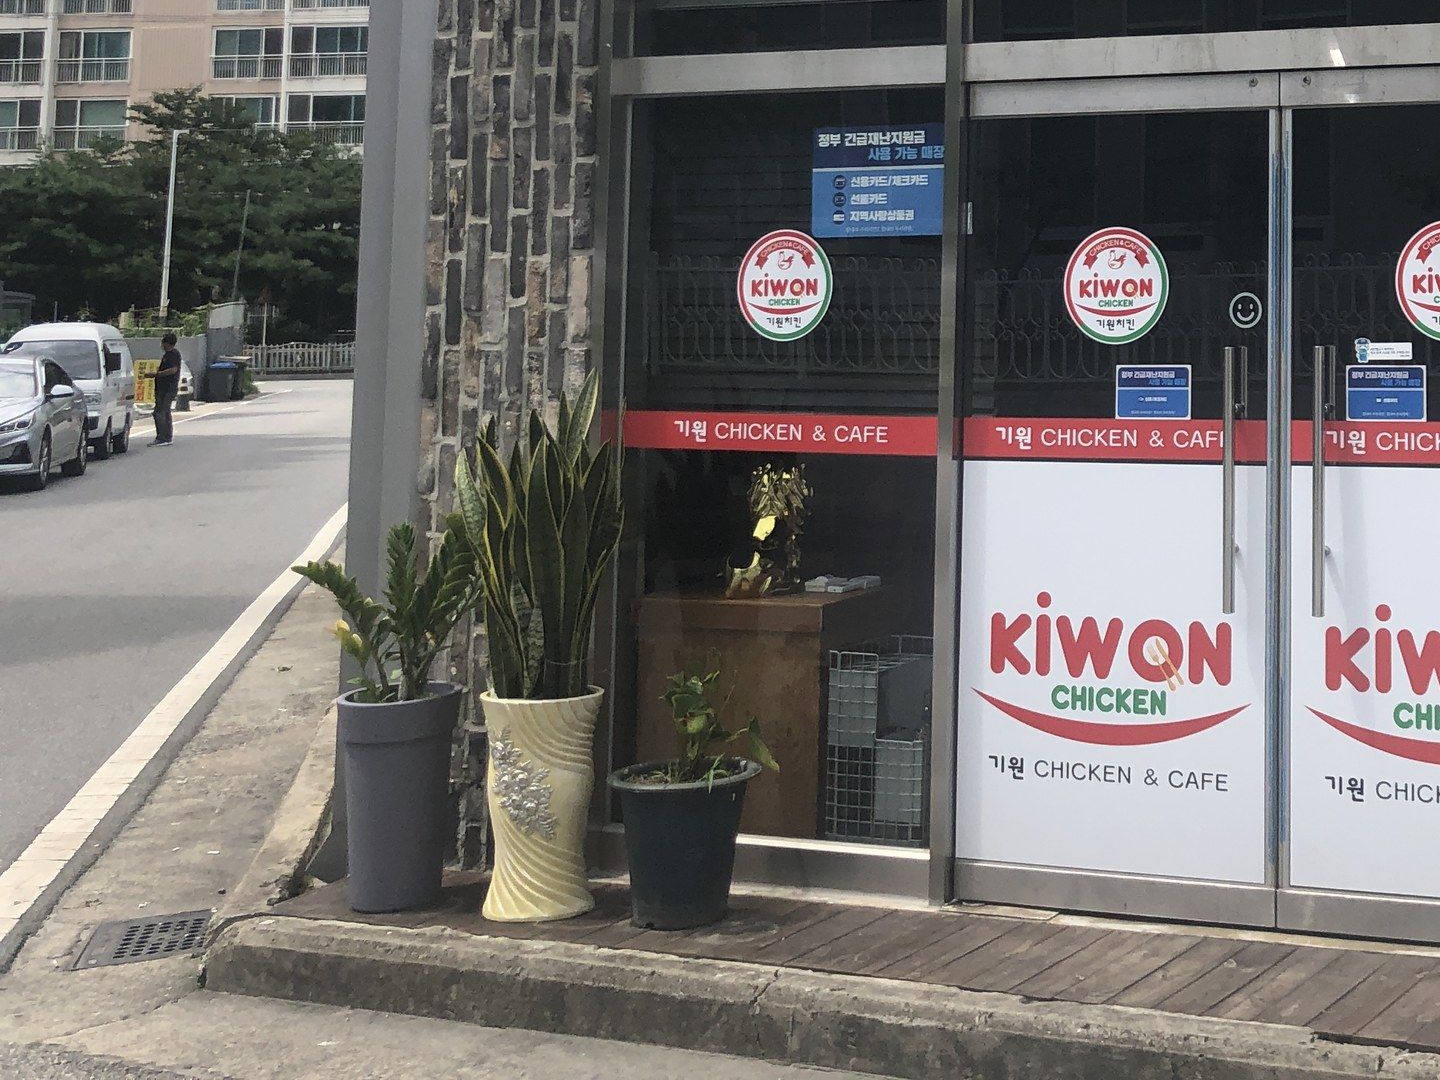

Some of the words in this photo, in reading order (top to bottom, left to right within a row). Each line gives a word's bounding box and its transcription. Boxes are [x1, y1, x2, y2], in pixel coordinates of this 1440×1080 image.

[818, 133, 842, 147] 정부
[844, 130, 926, 147] 긴급재난지원금
[868, 147, 891, 161] 사용
[894, 146, 918, 160] 가능
[921, 145, 945, 159] 매장
[768, 298, 800, 306] CHICKEN
[1098, 299, 1133, 307] CHICKEN
[766, 316, 802, 329] 기원치킨
[1096, 318, 1135, 331] 기원치킨
[674, 420, 707, 443] 기원
[714, 422, 802, 441] CHICKEN
[812, 425, 827, 442] &
[834, 425, 889, 443] CAFE
[995, 426, 1032, 450] 기원
[1040, 428, 1138, 447] CHICKEN
[1149, 430, 1164, 447] &
[1325, 430, 1367, 455] 기원
[1051, 684, 1167, 716] CHICKEN
[988, 755, 1024, 781] 기원
[1034, 759, 1132, 784] CHICKEN
[1143, 768, 1159, 786] &
[1168, 770, 1229, 792] CAFE
[1324, 775, 1365, 802] 기원
